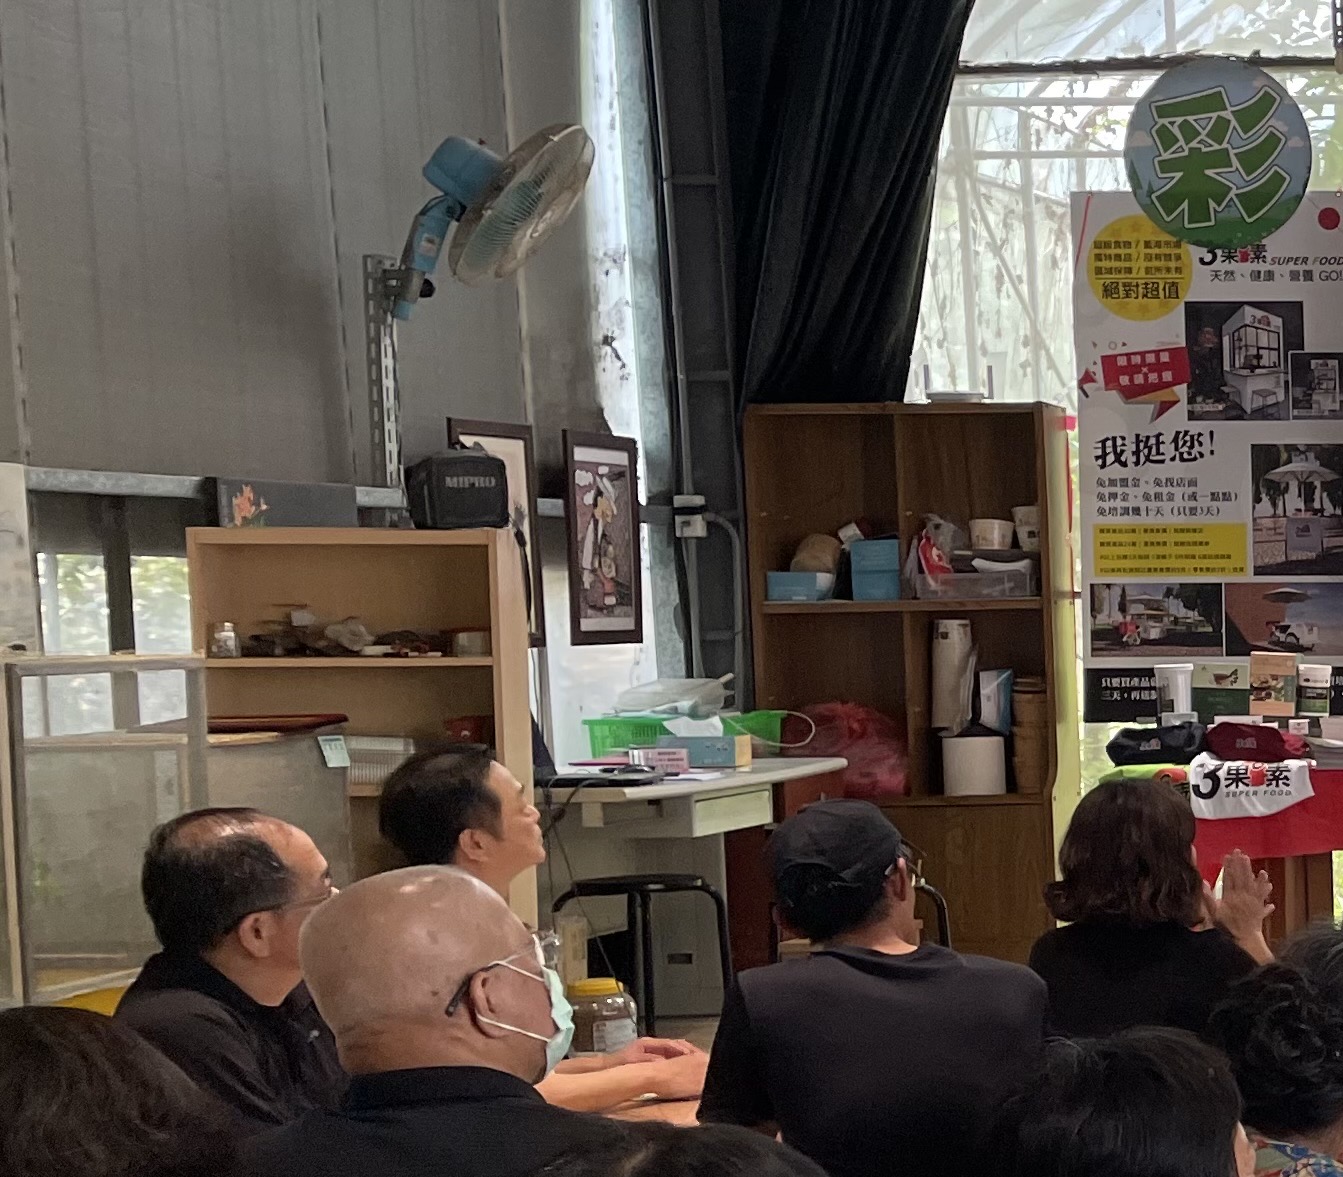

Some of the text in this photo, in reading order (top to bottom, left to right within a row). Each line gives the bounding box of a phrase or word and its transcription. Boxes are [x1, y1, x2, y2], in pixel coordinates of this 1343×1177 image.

[1150, 85, 1290, 228] 彩
[1198, 244, 1268, 266] 3果素
[1269, 256, 1309, 266] SUPER
[1102, 282, 1180, 300] 絕對超值
[443, 474, 496, 489] MIPRO
